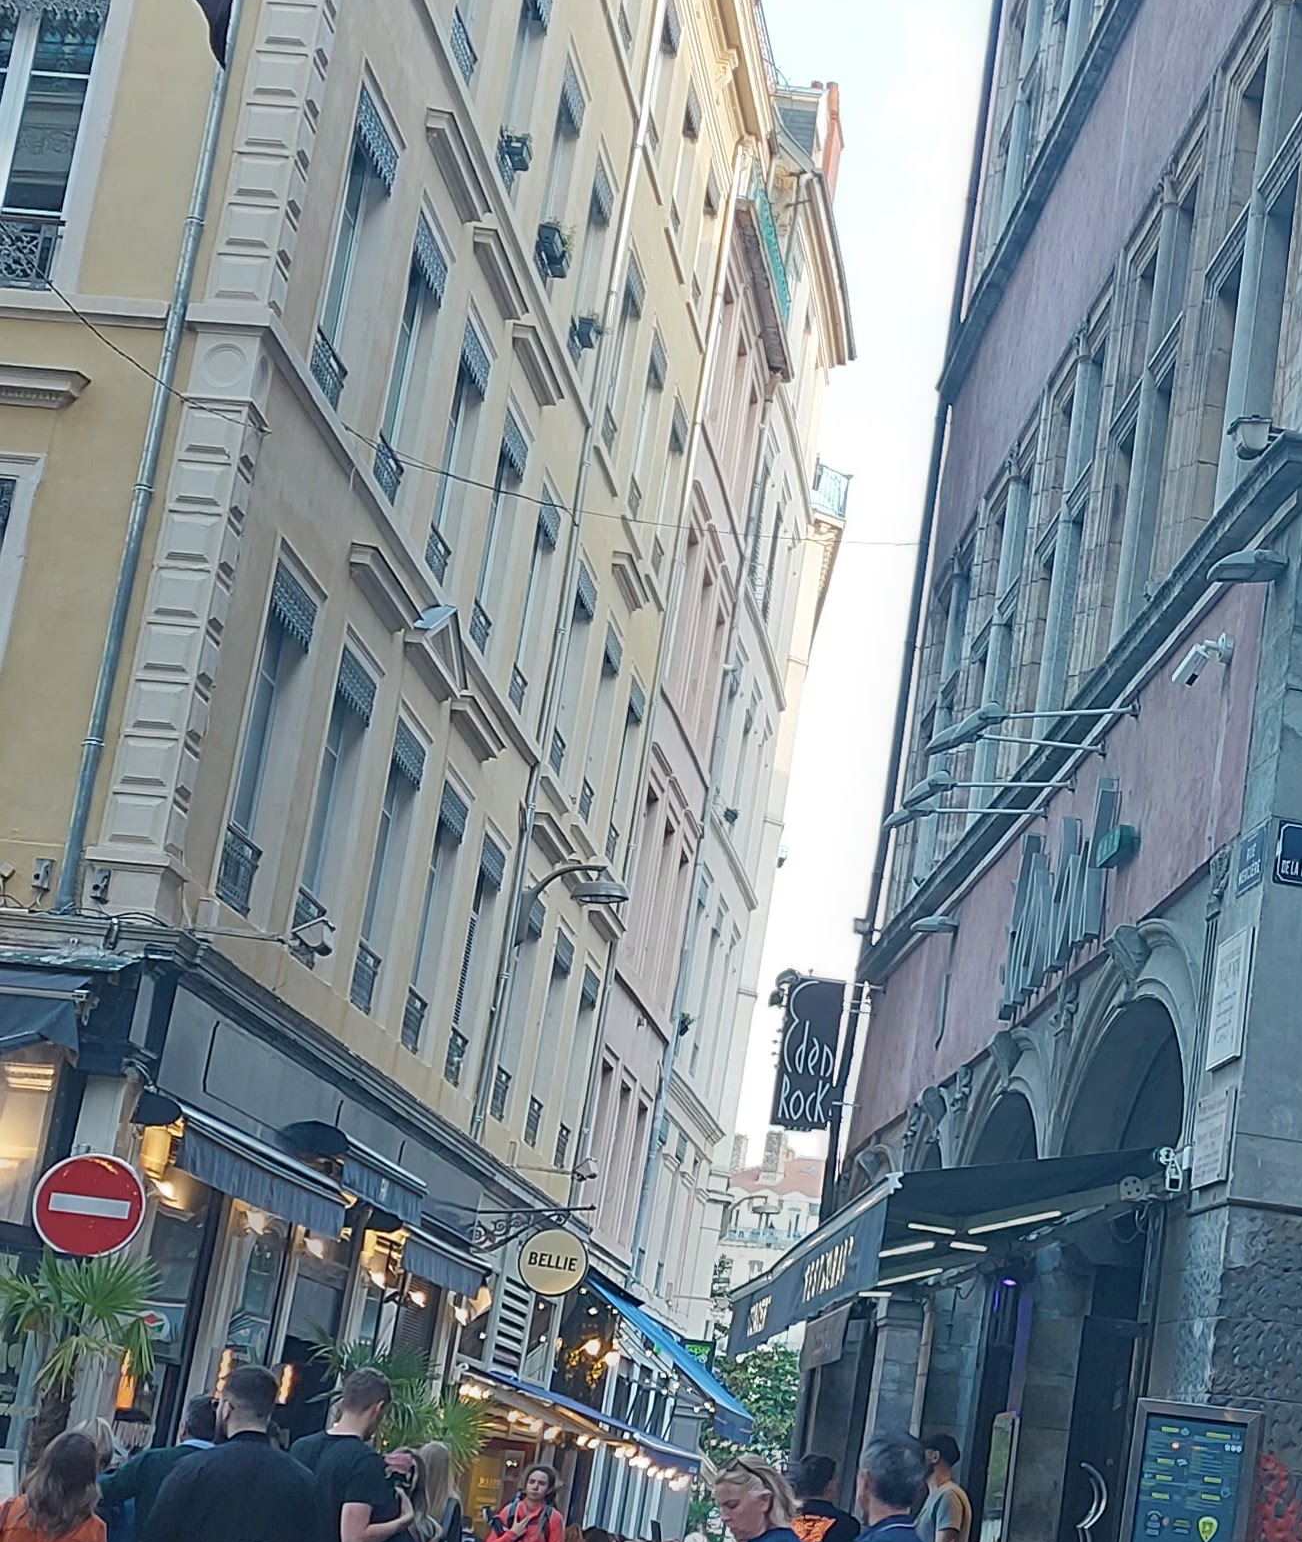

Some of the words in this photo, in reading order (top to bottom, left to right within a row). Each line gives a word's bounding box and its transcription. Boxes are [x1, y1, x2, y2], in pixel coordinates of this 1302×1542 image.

[1281, 859, 1291, 875] DE
[783, 980, 834, 1077] Eden
[527, 1251, 579, 1272] BELLIE
